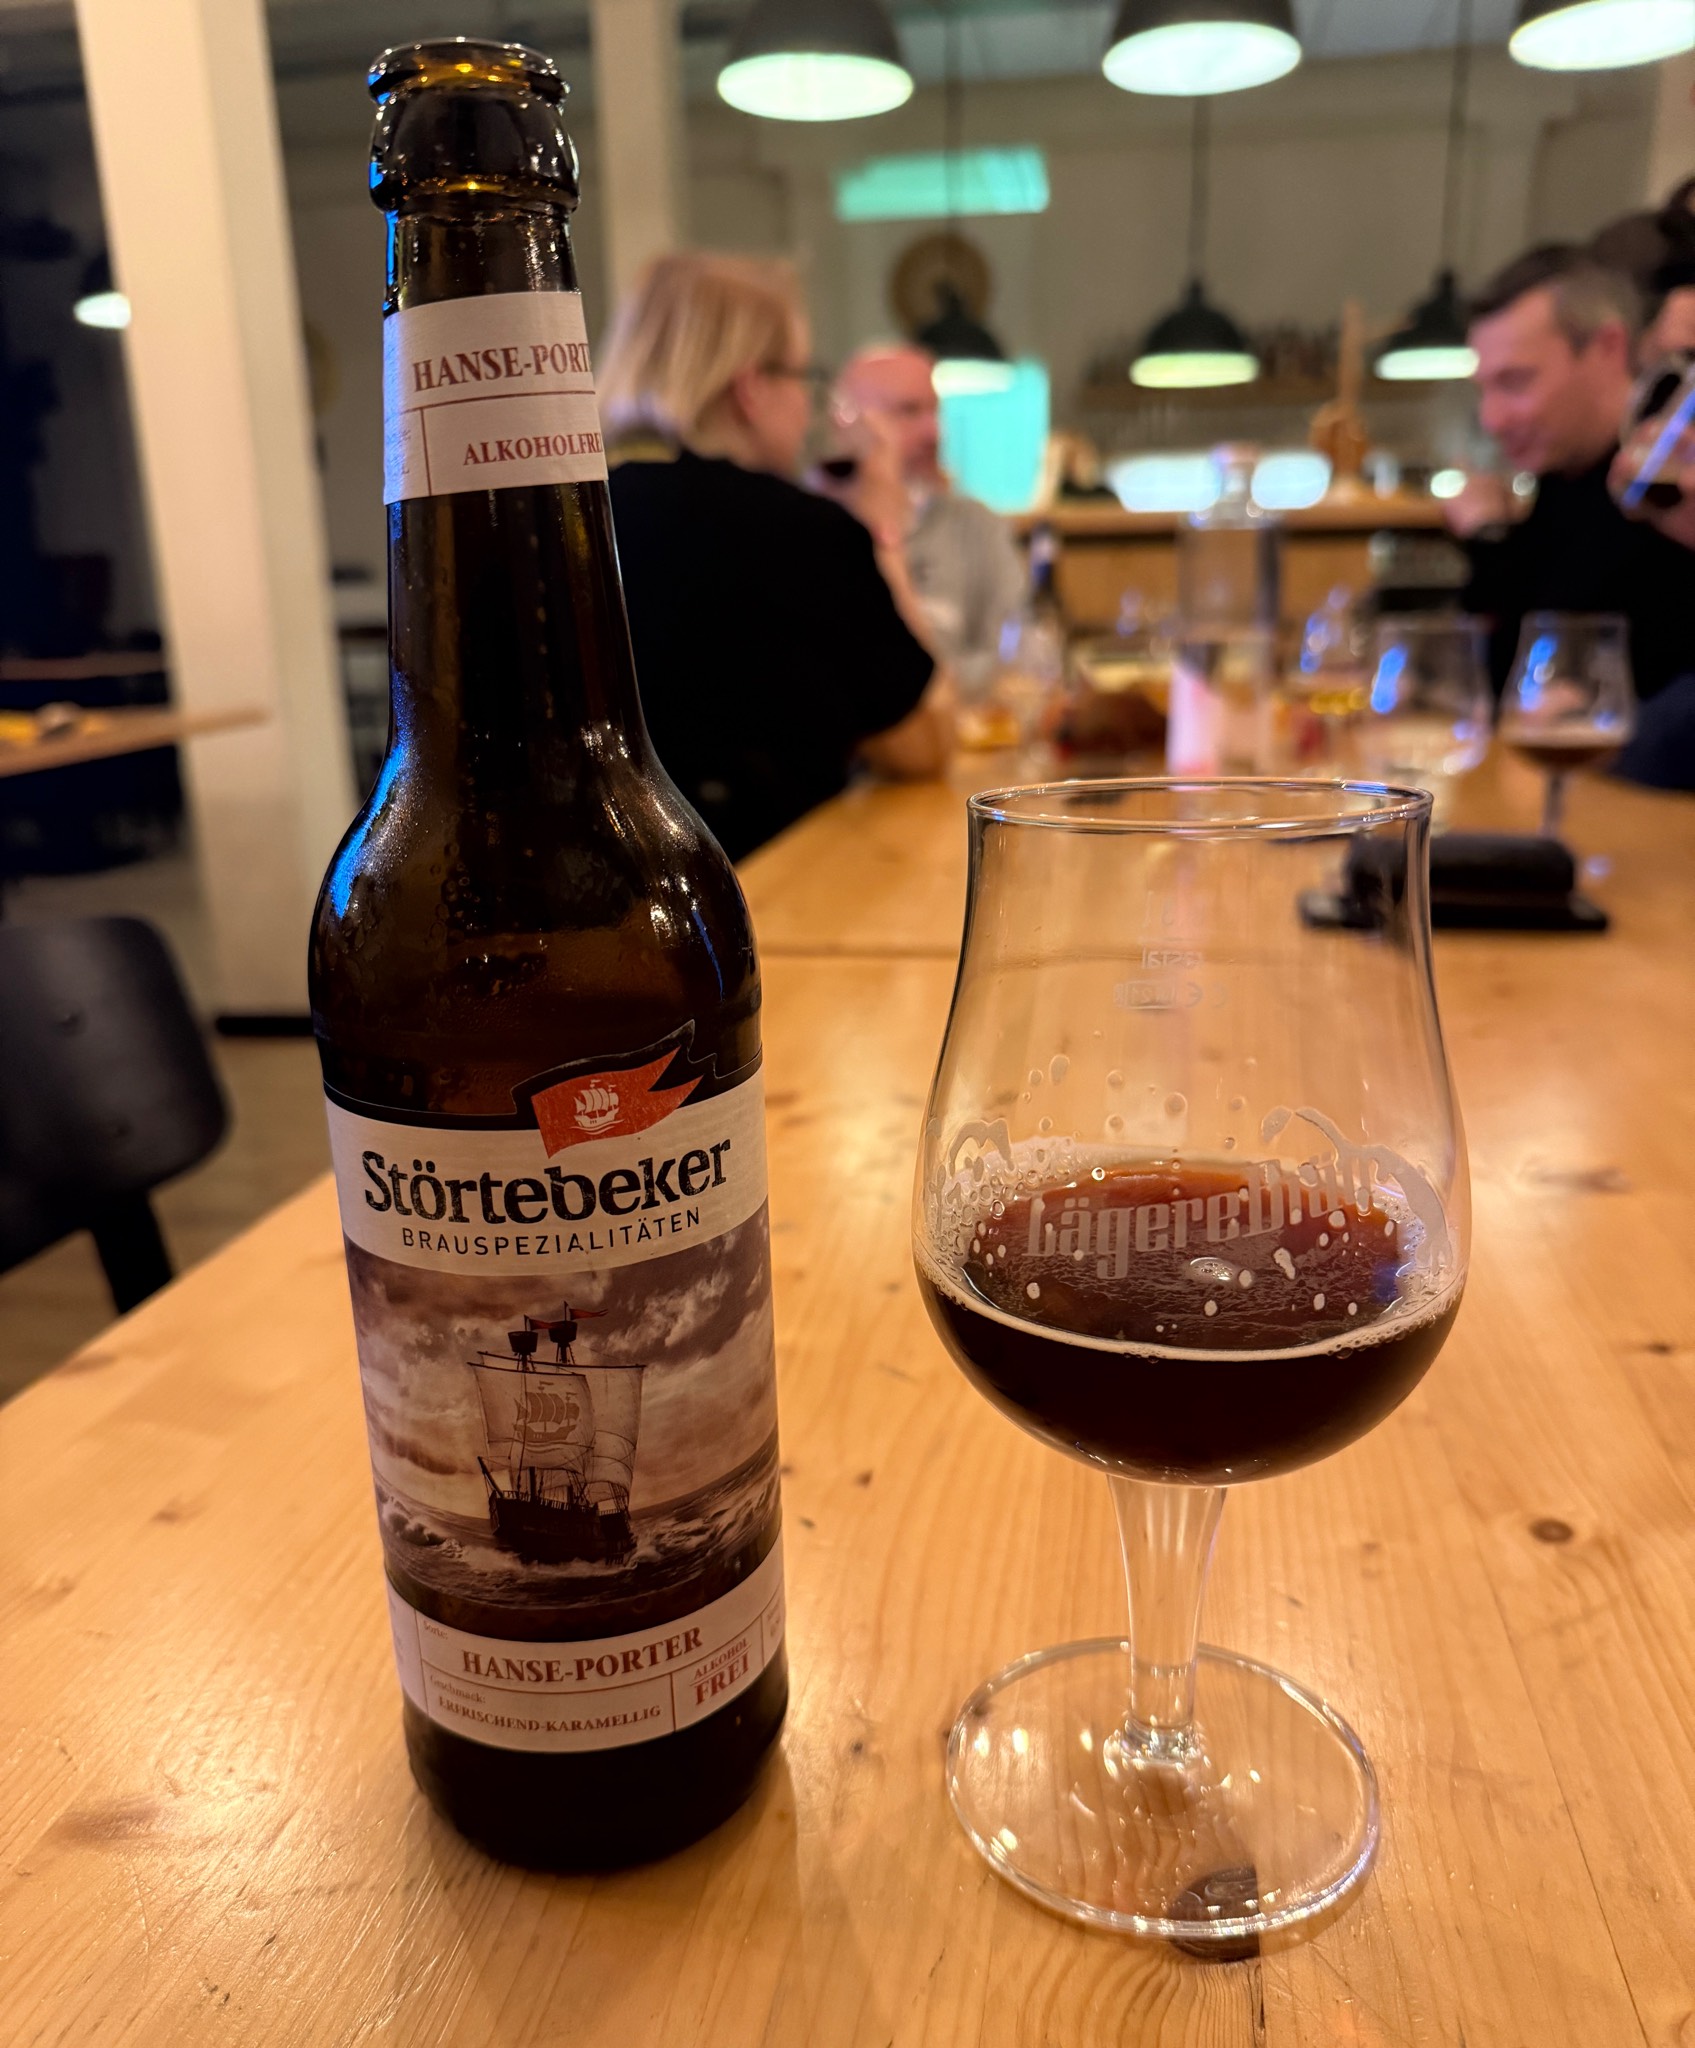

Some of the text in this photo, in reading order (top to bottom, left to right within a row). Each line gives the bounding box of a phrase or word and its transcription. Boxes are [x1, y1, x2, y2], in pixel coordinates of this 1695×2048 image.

[413, 342, 592, 393] HANSE-PORT
[462, 431, 604, 466] ALKOHOLFRE
[362, 1139, 731, 1225] Störtebeker
[402, 1206, 701, 1256] BRAUSPEZIALITÄTEN
[461, 1626, 704, 1683] HANSE-PORTER
[693, 1636, 748, 1681] ALKOHOL
[694, 1651, 750, 1706] FREI
